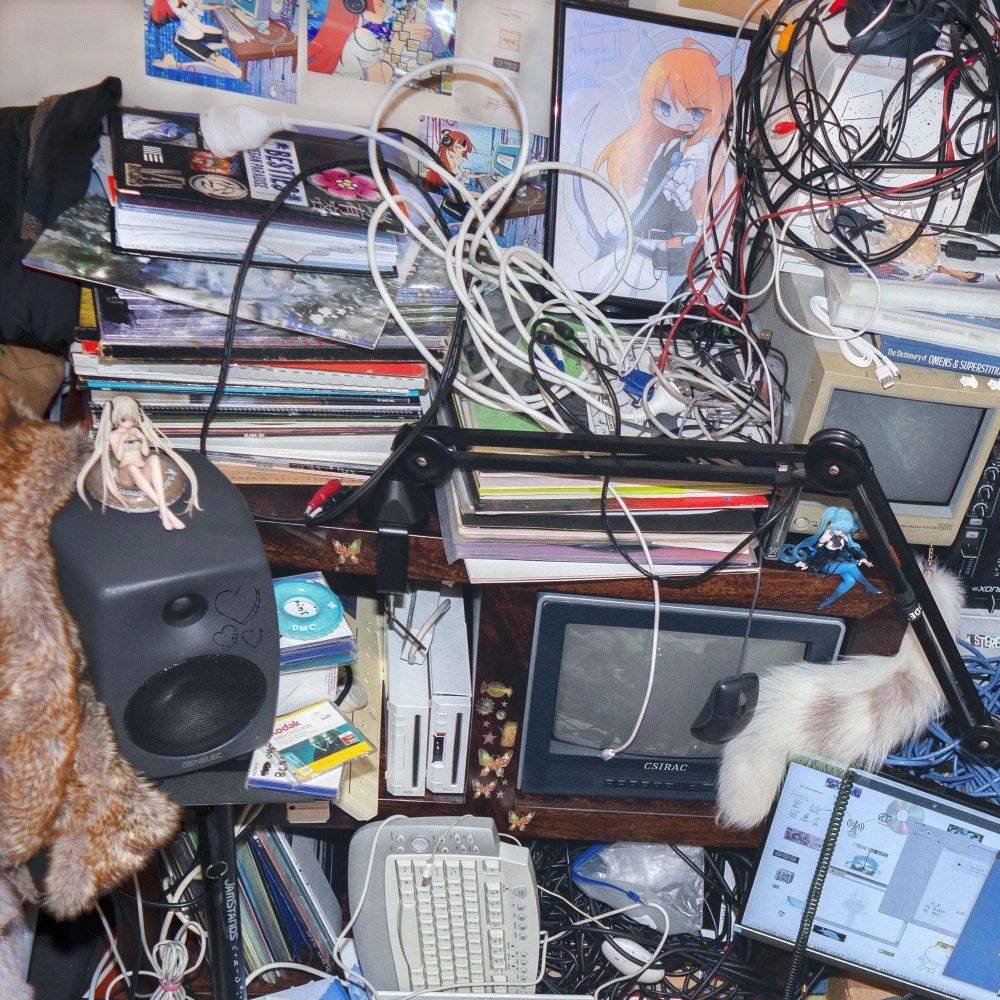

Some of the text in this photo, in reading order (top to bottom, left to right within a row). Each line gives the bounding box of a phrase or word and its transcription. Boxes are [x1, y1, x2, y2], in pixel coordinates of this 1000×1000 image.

[887, 348, 898, 357] The
[897, 349, 921, 363] Dictionary
[928, 354, 952, 369] OMENS
[292, 624, 317, 632] DMC
[181, 752, 223, 770] GENELEC
[643, 760, 689, 772] CSIRAC
[224, 876, 239, 942] JAMSTANDS
